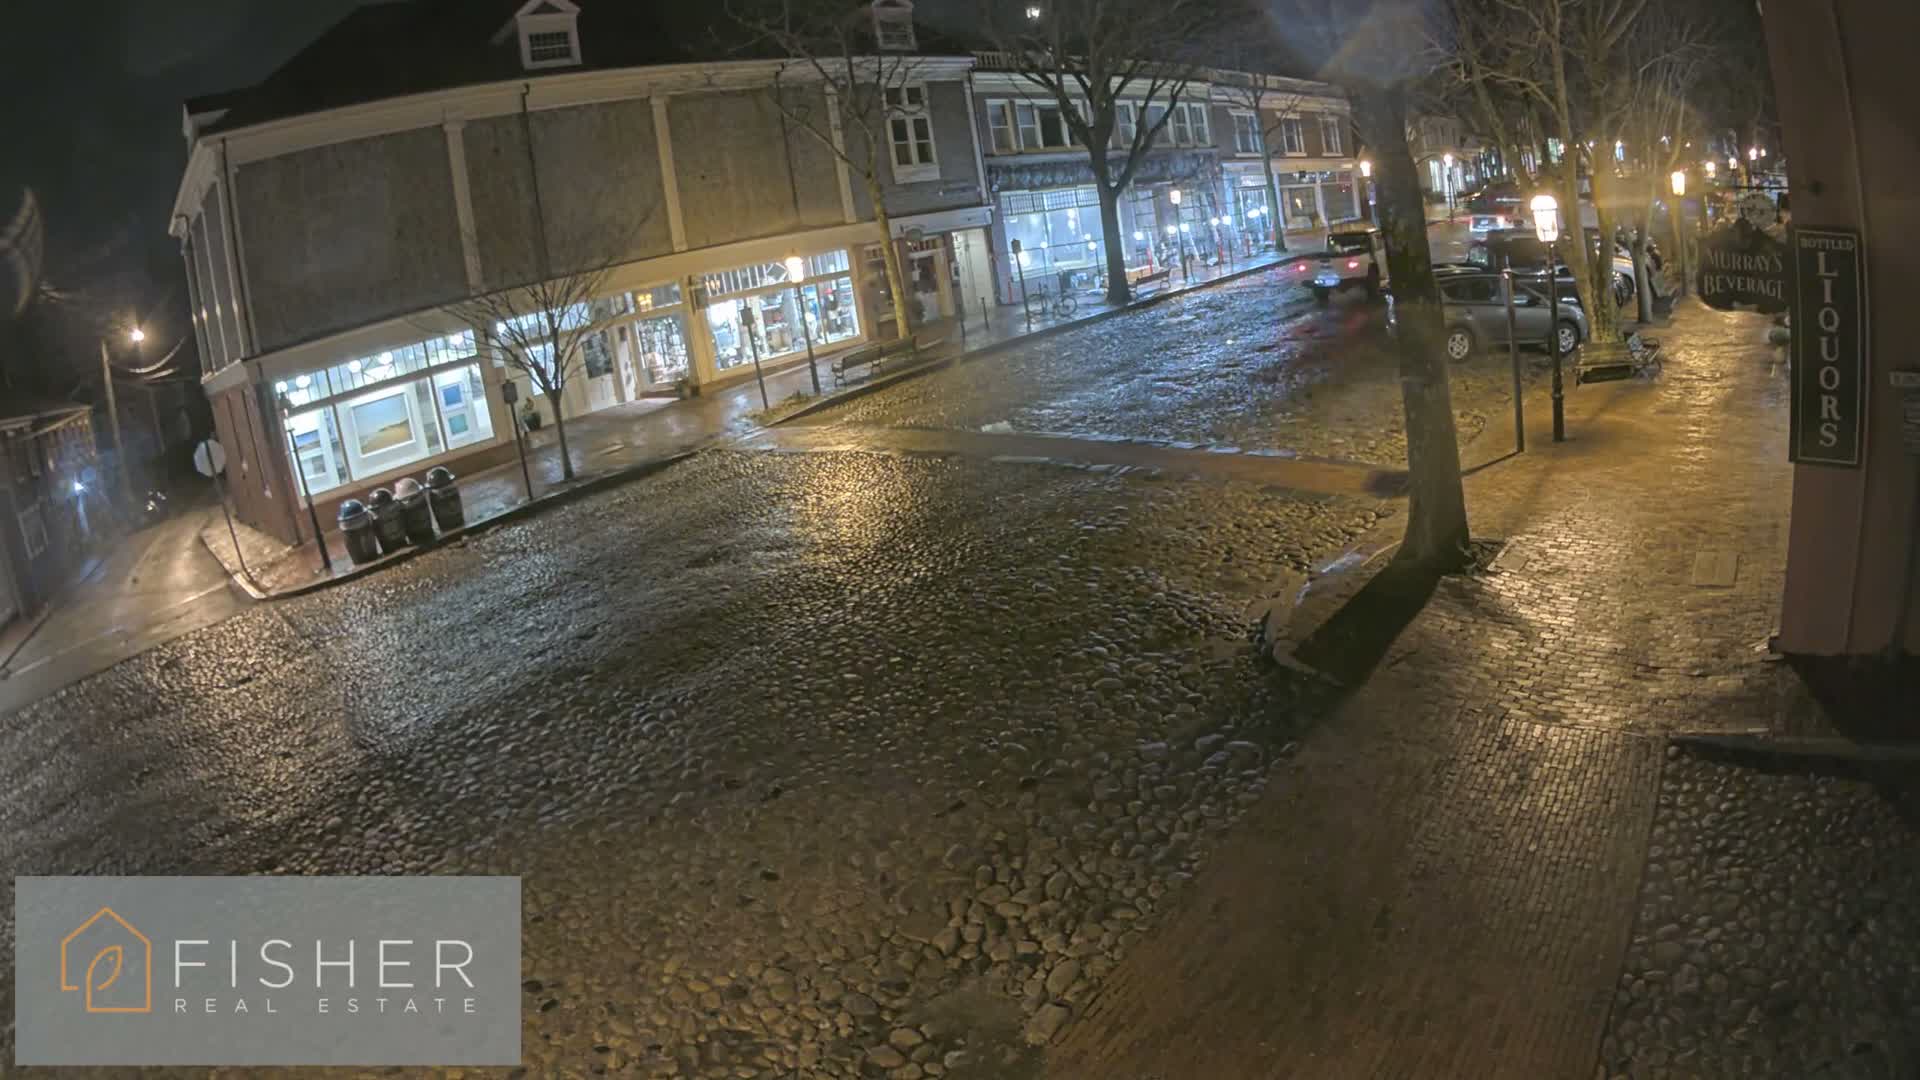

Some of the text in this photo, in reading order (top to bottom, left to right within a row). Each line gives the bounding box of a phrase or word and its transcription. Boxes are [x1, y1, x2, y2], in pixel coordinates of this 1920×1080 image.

[1800, 237, 1855, 251] BOTTLED
[1703, 273, 1785, 300] BEVERAGE
[1816, 251, 1842, 448] LIQUORS
